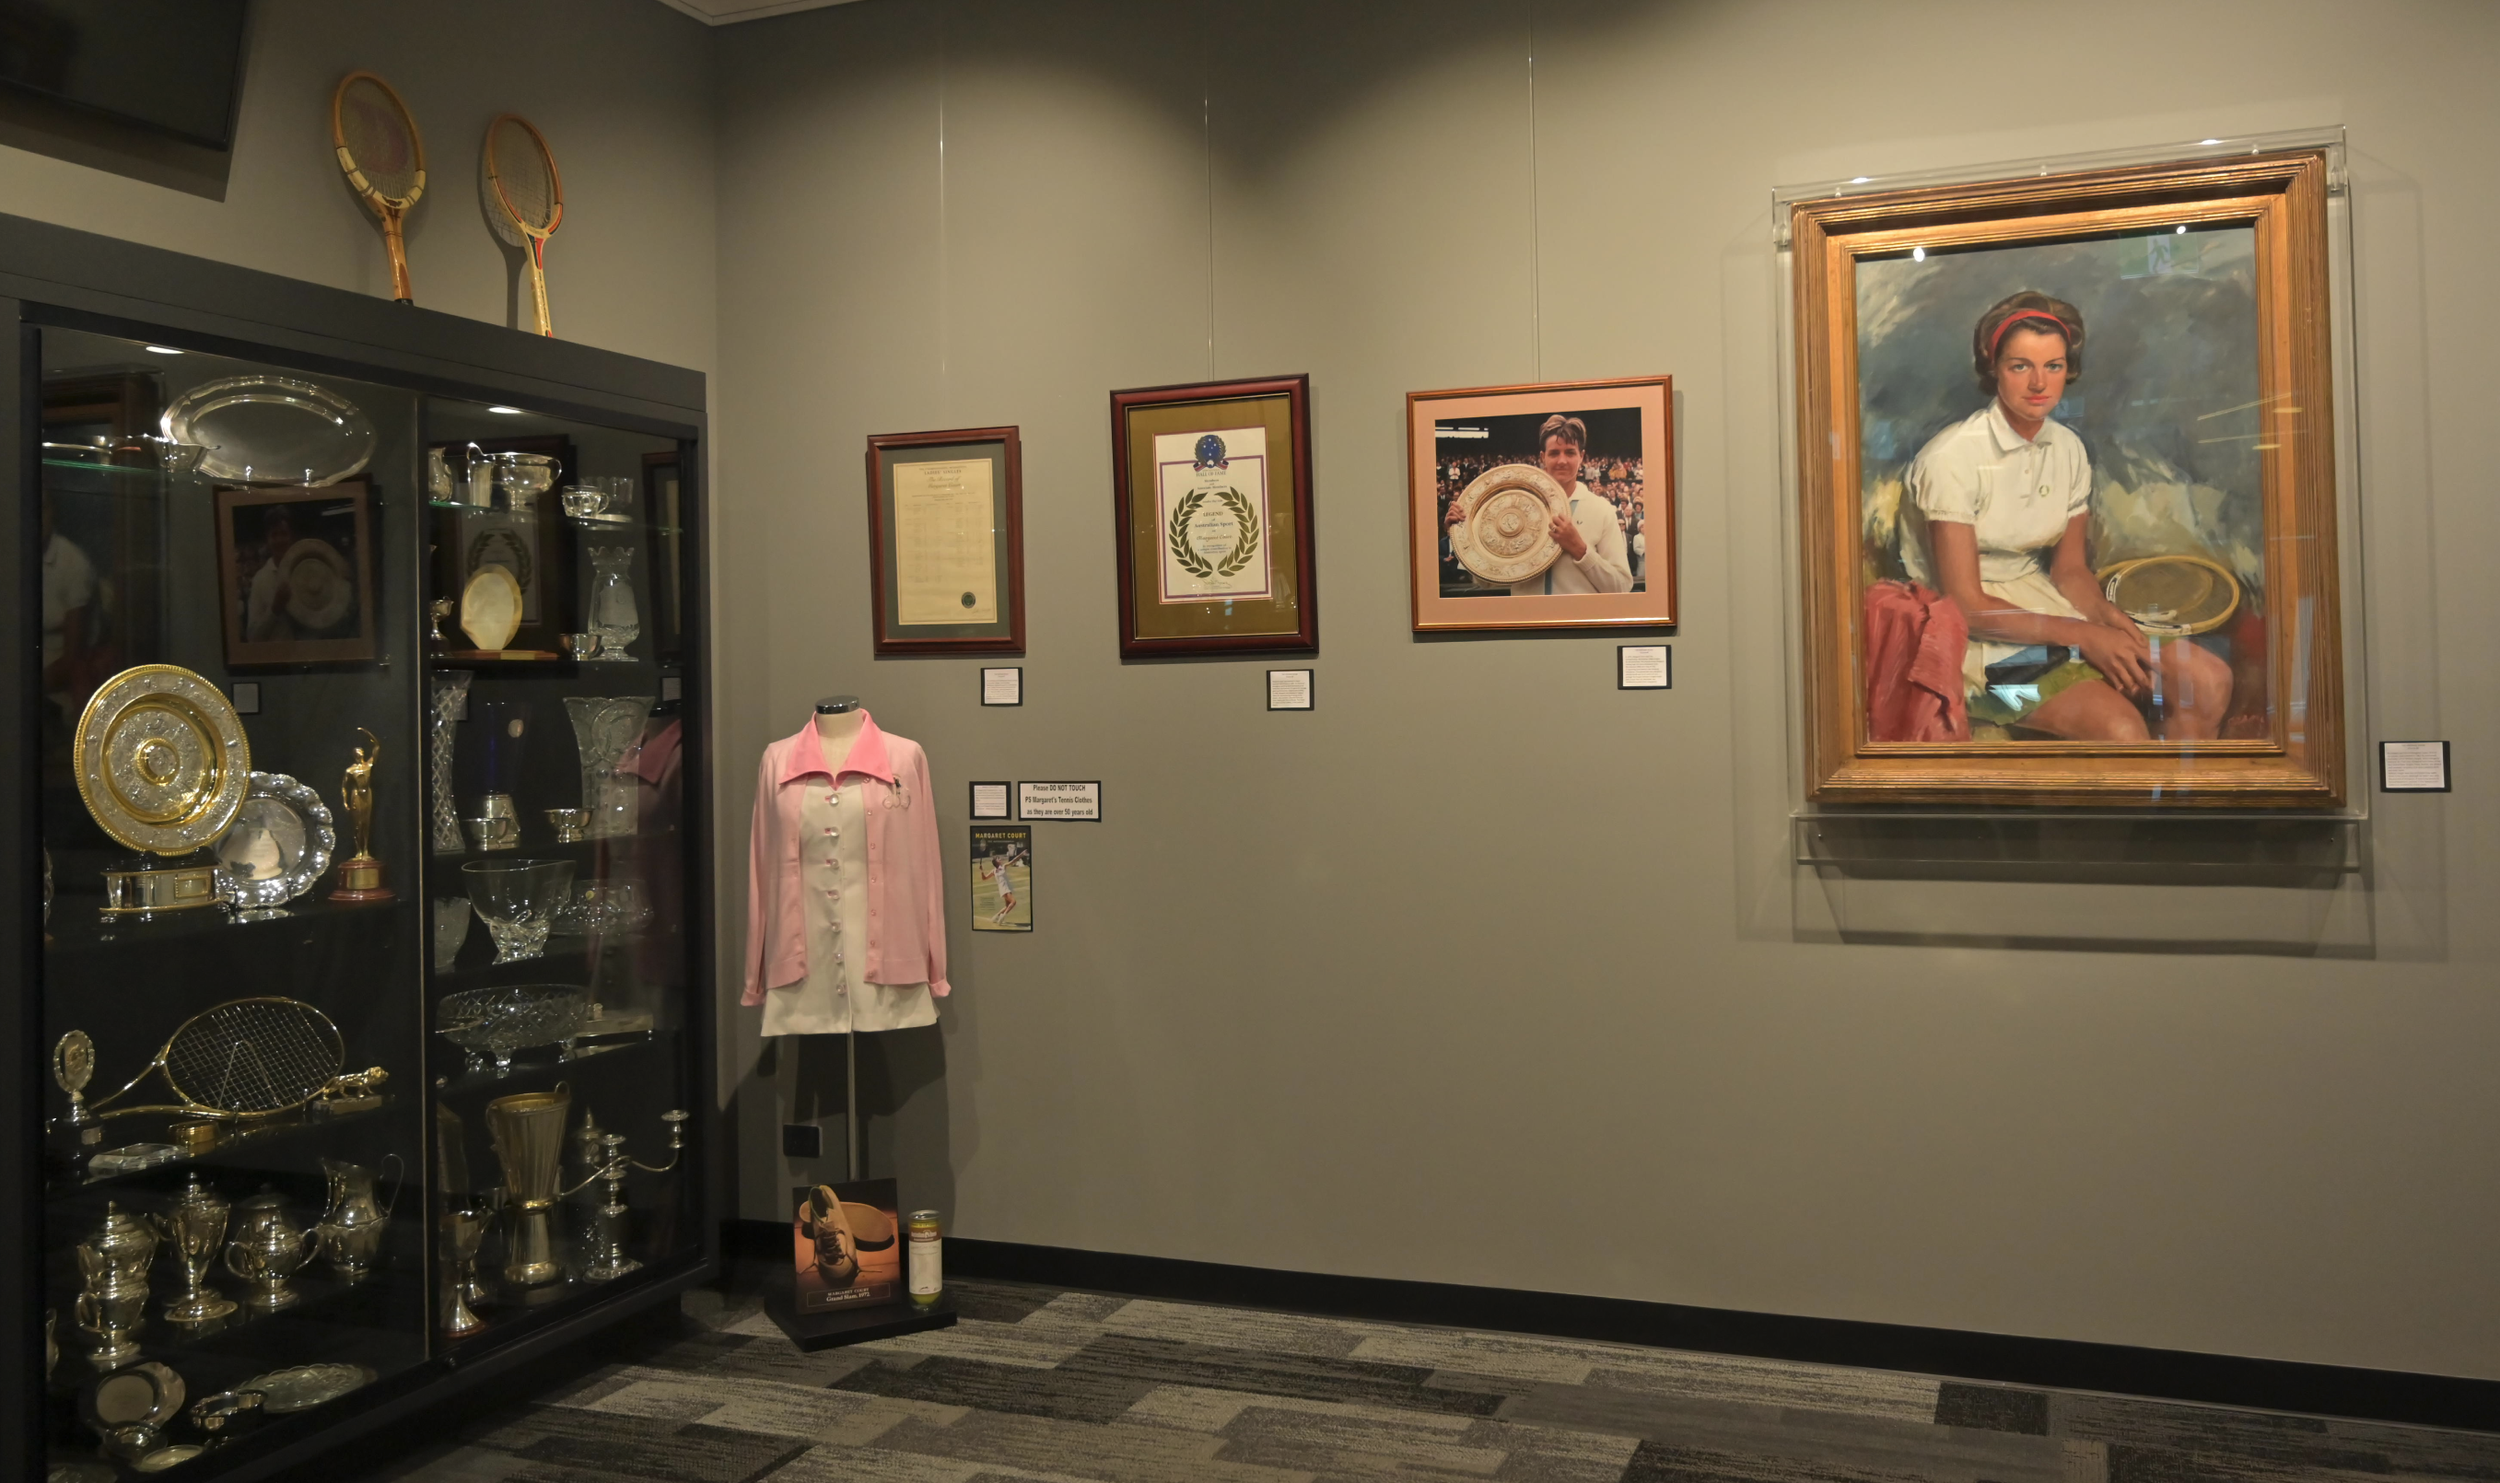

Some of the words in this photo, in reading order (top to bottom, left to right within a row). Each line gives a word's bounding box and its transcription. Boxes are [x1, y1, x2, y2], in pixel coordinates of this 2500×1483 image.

[1032, 796, 1057, 805] Margaret's
[1074, 796, 1093, 804] Clothes
[1033, 808, 1044, 816] they
[1071, 809, 1085, 817] years
